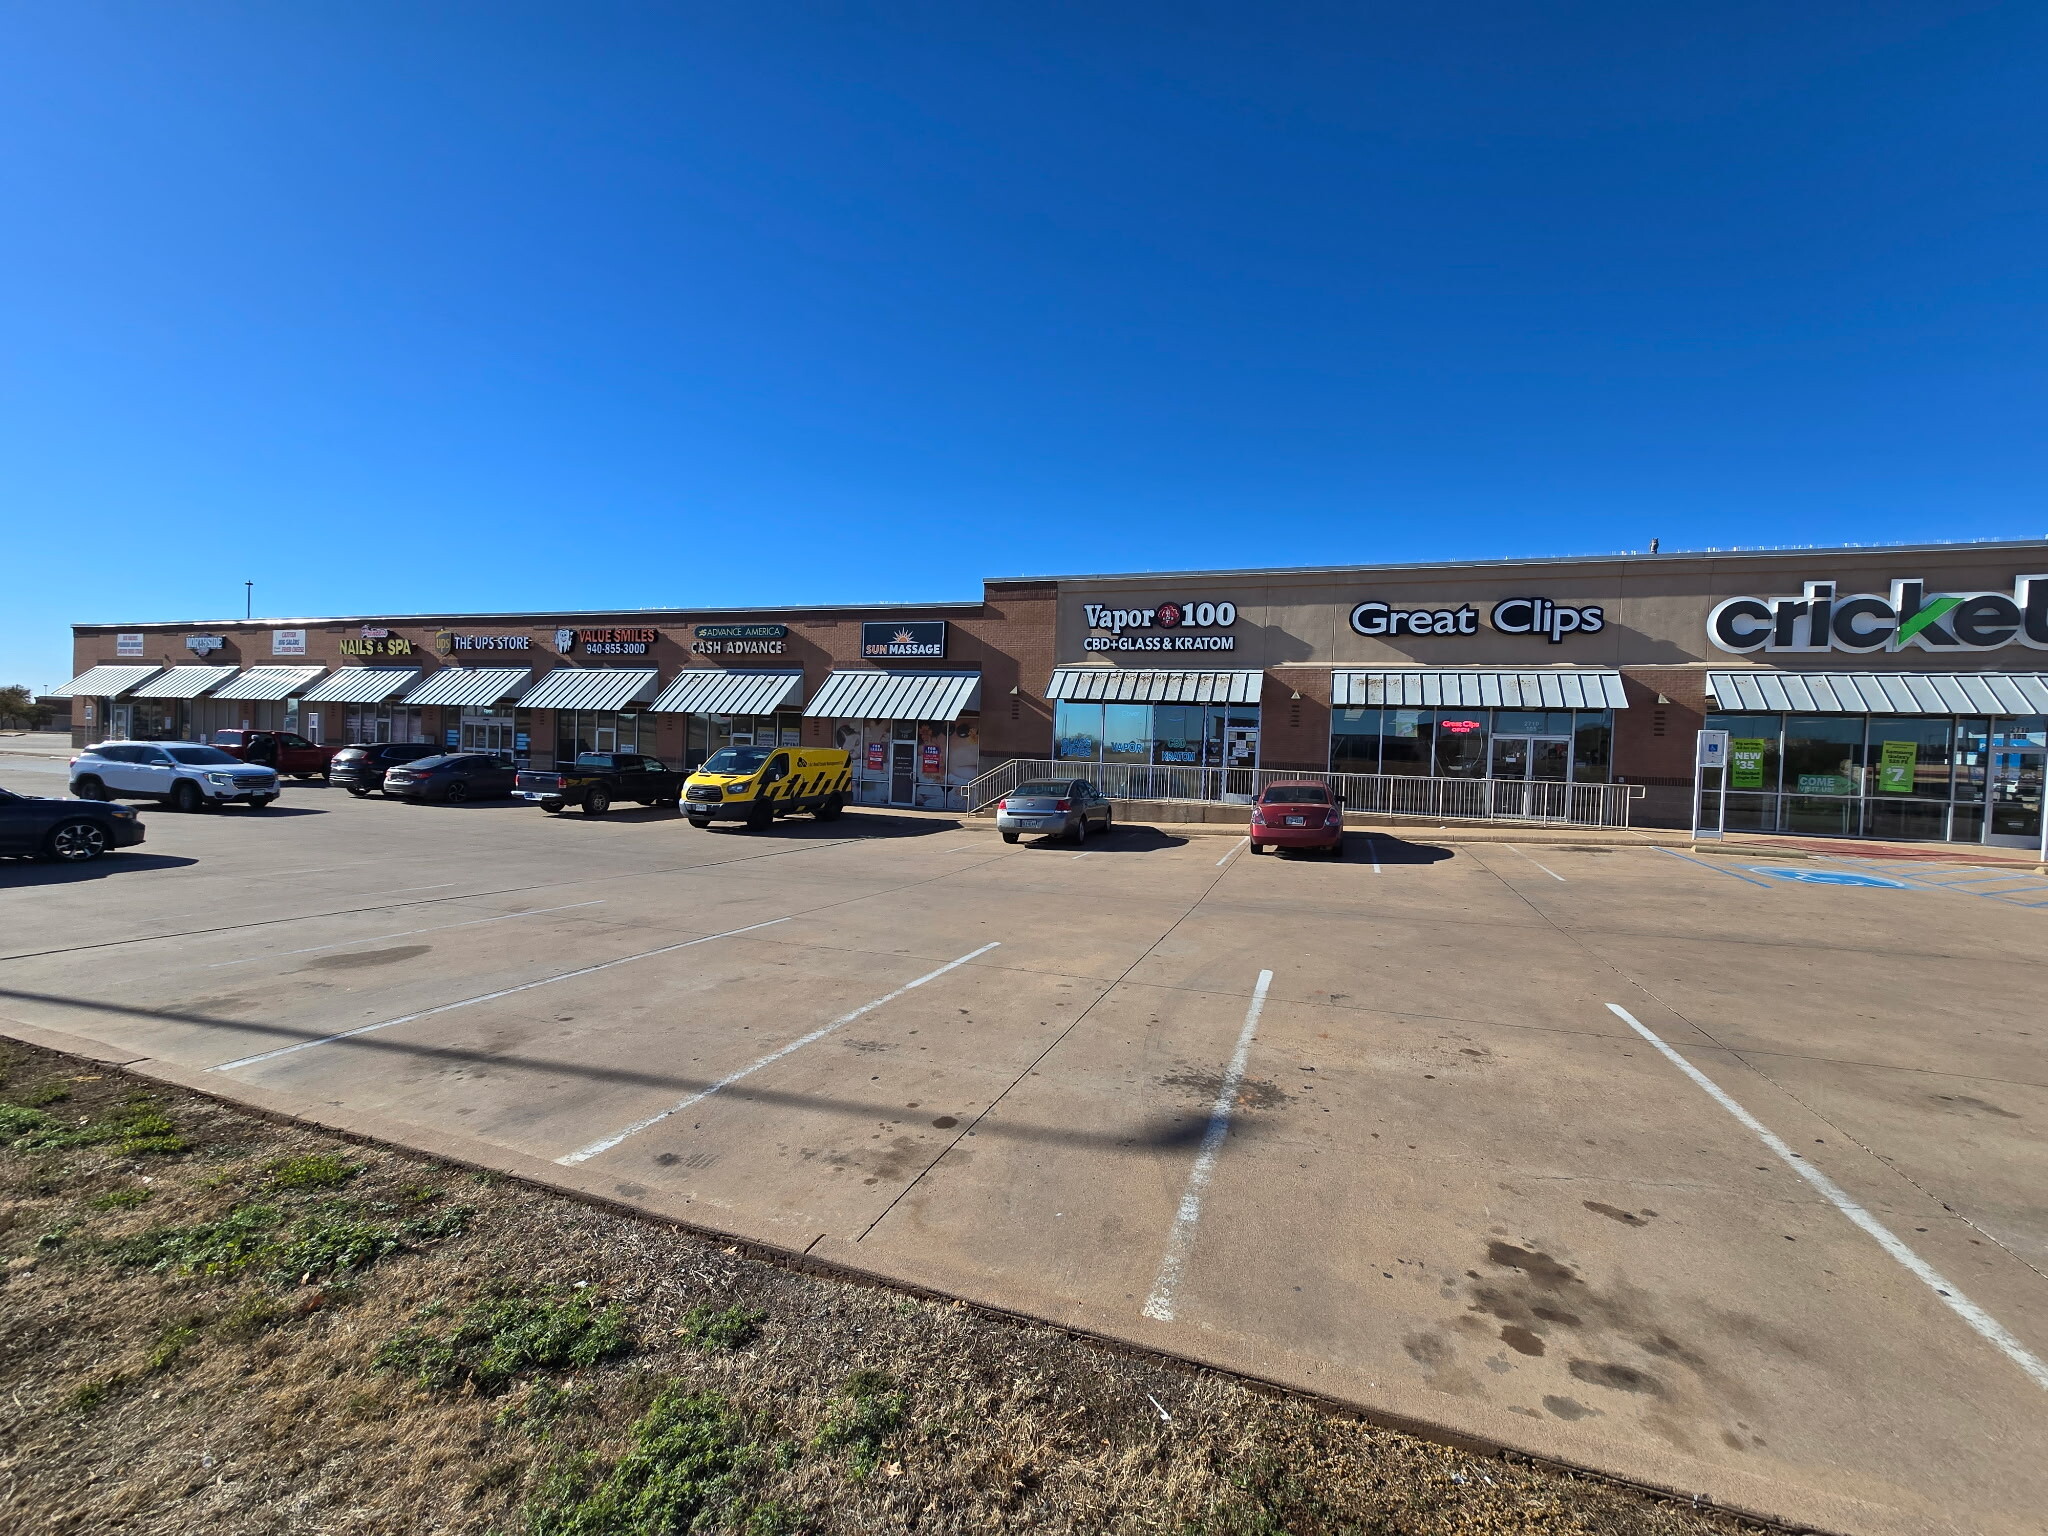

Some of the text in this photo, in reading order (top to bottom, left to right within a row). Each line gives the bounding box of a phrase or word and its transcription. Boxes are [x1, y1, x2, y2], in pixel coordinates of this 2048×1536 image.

[1083, 602, 1236, 634] Vapor 100
[1352, 599, 1602, 641] Great Clips
[579, 628, 655, 643] VALUE SMILES
[707, 626, 781, 637] ADVANCE AMERICA
[339, 639, 412, 656] NAILS & SPA
[454, 636, 529, 650] THE UPS STORE
[586, 643, 646, 655] 940-855-3000
[691, 640, 782, 654] CASH ADVANCE
[865, 643, 941, 655] SUN MASSAGE
[1083, 636, 1234, 651] CBD+GLASS & KRATOM
[1061, 738, 1092, 748] GLASS
[1111, 741, 1144, 753] VAPOR
[1168, 738, 1186, 748] CBD
[1061, 747, 1092, 757] PIPES
[1162, 751, 1196, 762] KRATOM
[1735, 751, 1761, 760] NEW
[1735, 760, 1755, 769] $35
[1886, 767, 1905, 782] $7
[1800, 776, 1835, 787] COME
